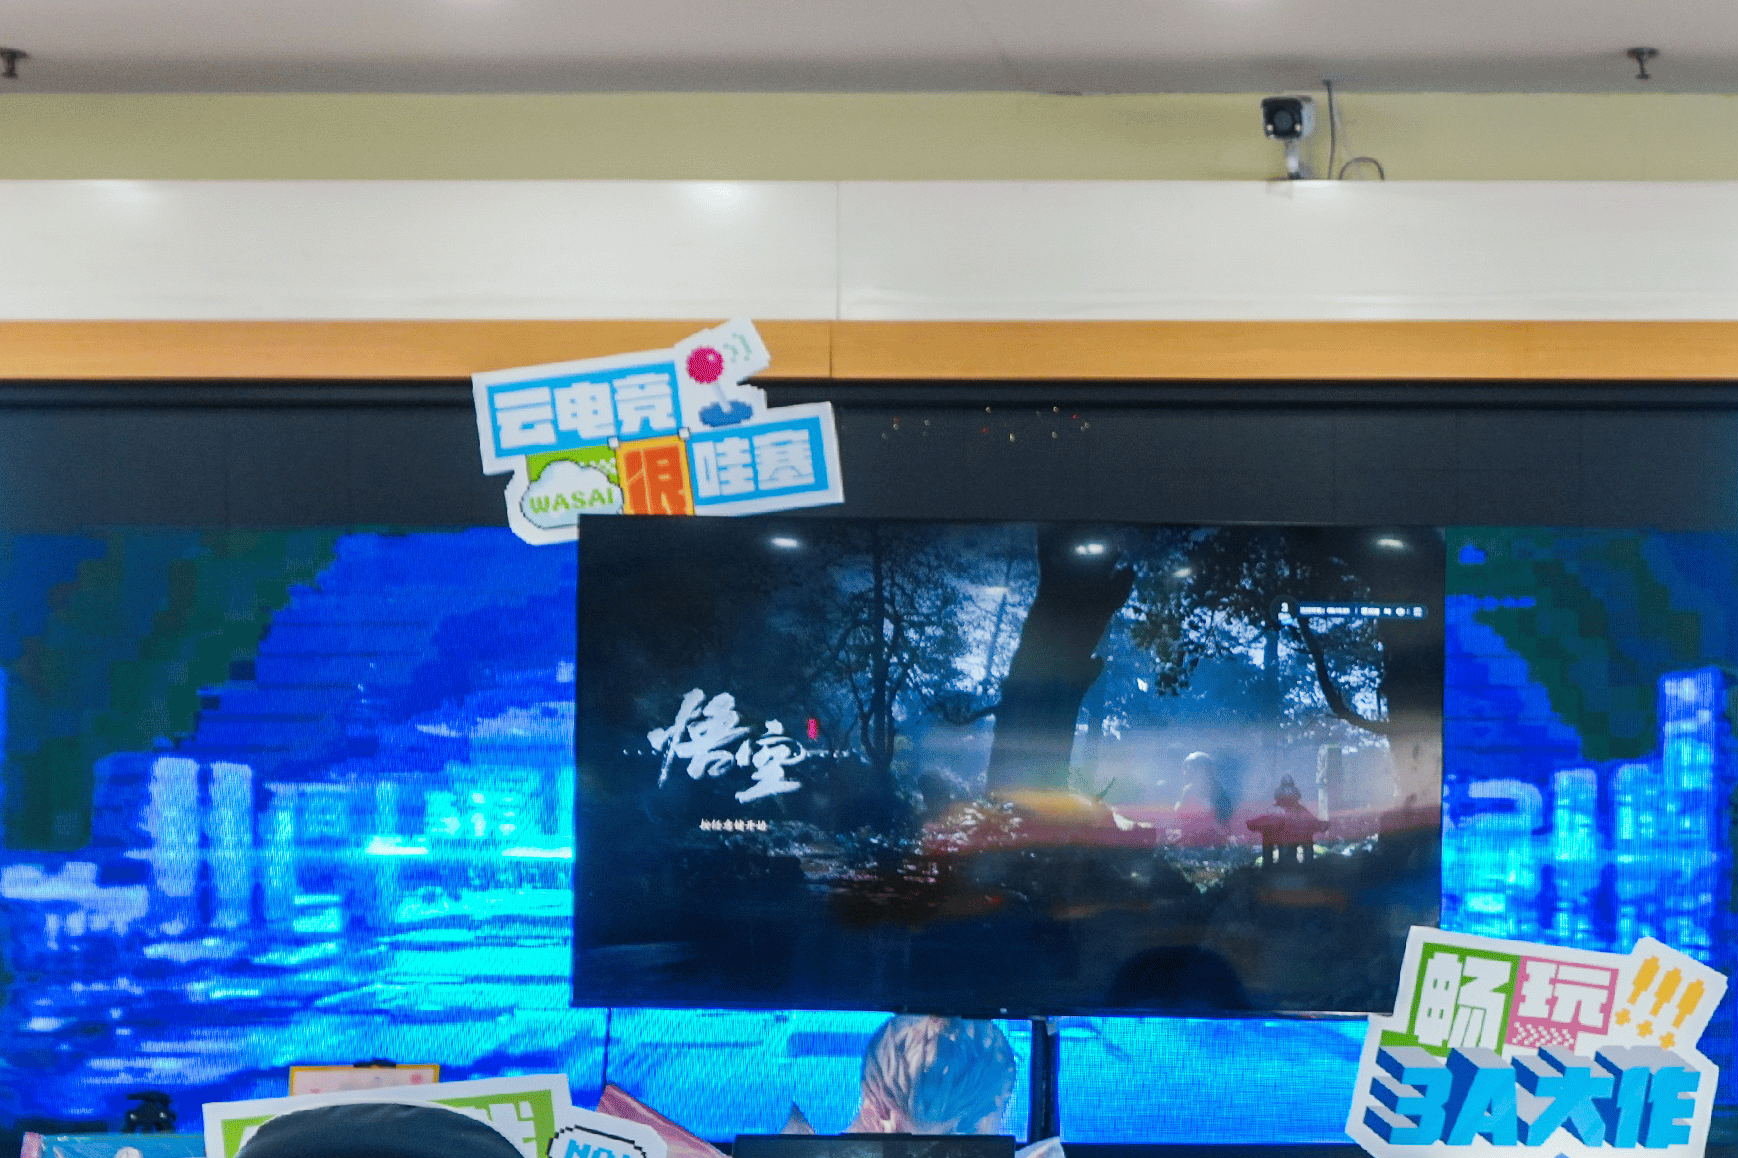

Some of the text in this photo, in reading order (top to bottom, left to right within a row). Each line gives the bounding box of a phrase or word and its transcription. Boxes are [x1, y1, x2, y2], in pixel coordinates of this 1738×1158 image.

[493, 373, 677, 449] 云电竞
[529, 488, 614, 514] WASAI
[1374, 1055, 1701, 1149] 3A大作
